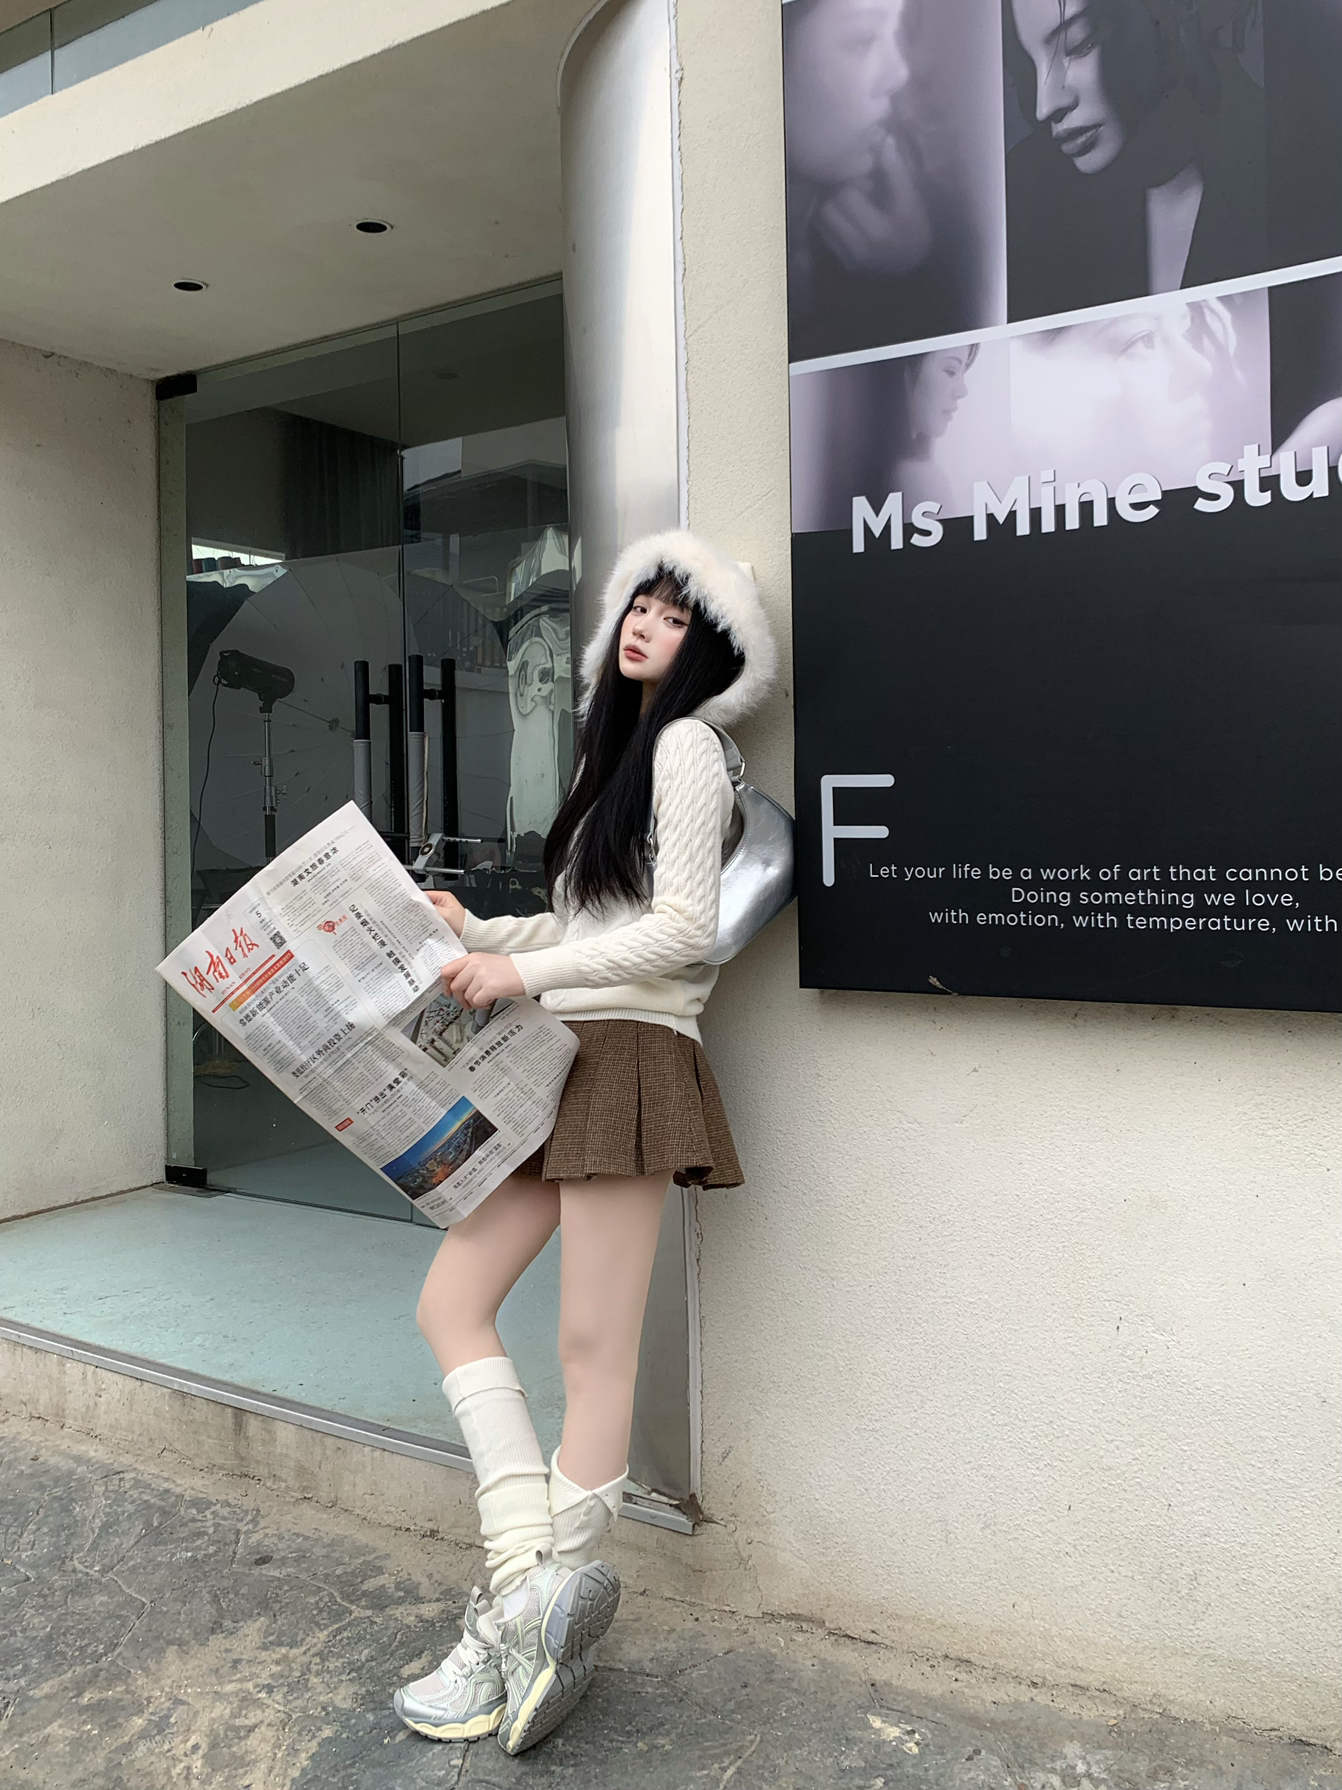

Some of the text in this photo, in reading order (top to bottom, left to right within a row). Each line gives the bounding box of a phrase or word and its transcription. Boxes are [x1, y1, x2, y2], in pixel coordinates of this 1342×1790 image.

[852, 444, 1342, 553] Ms Mine stu
[821, 774, 895, 887] F
[869, 864, 897, 878] Let
[904, 867, 945, 881] your
[952, 864, 981, 879] life
[988, 864, 1012, 880] be
[1020, 868, 1032, 880] a
[1040, 864, 1091, 881] work
[1098, 865, 1121, 881] of
[1128, 865, 1160, 881] art
[1168, 865, 1217, 881] that
[1225, 865, 1309, 881] cannot
[929, 908, 1338, 933] with emotion, with temperature, with
[1011, 888, 1300, 908] Doing something we love,
[180, 927, 260, 999] 湖南日报
